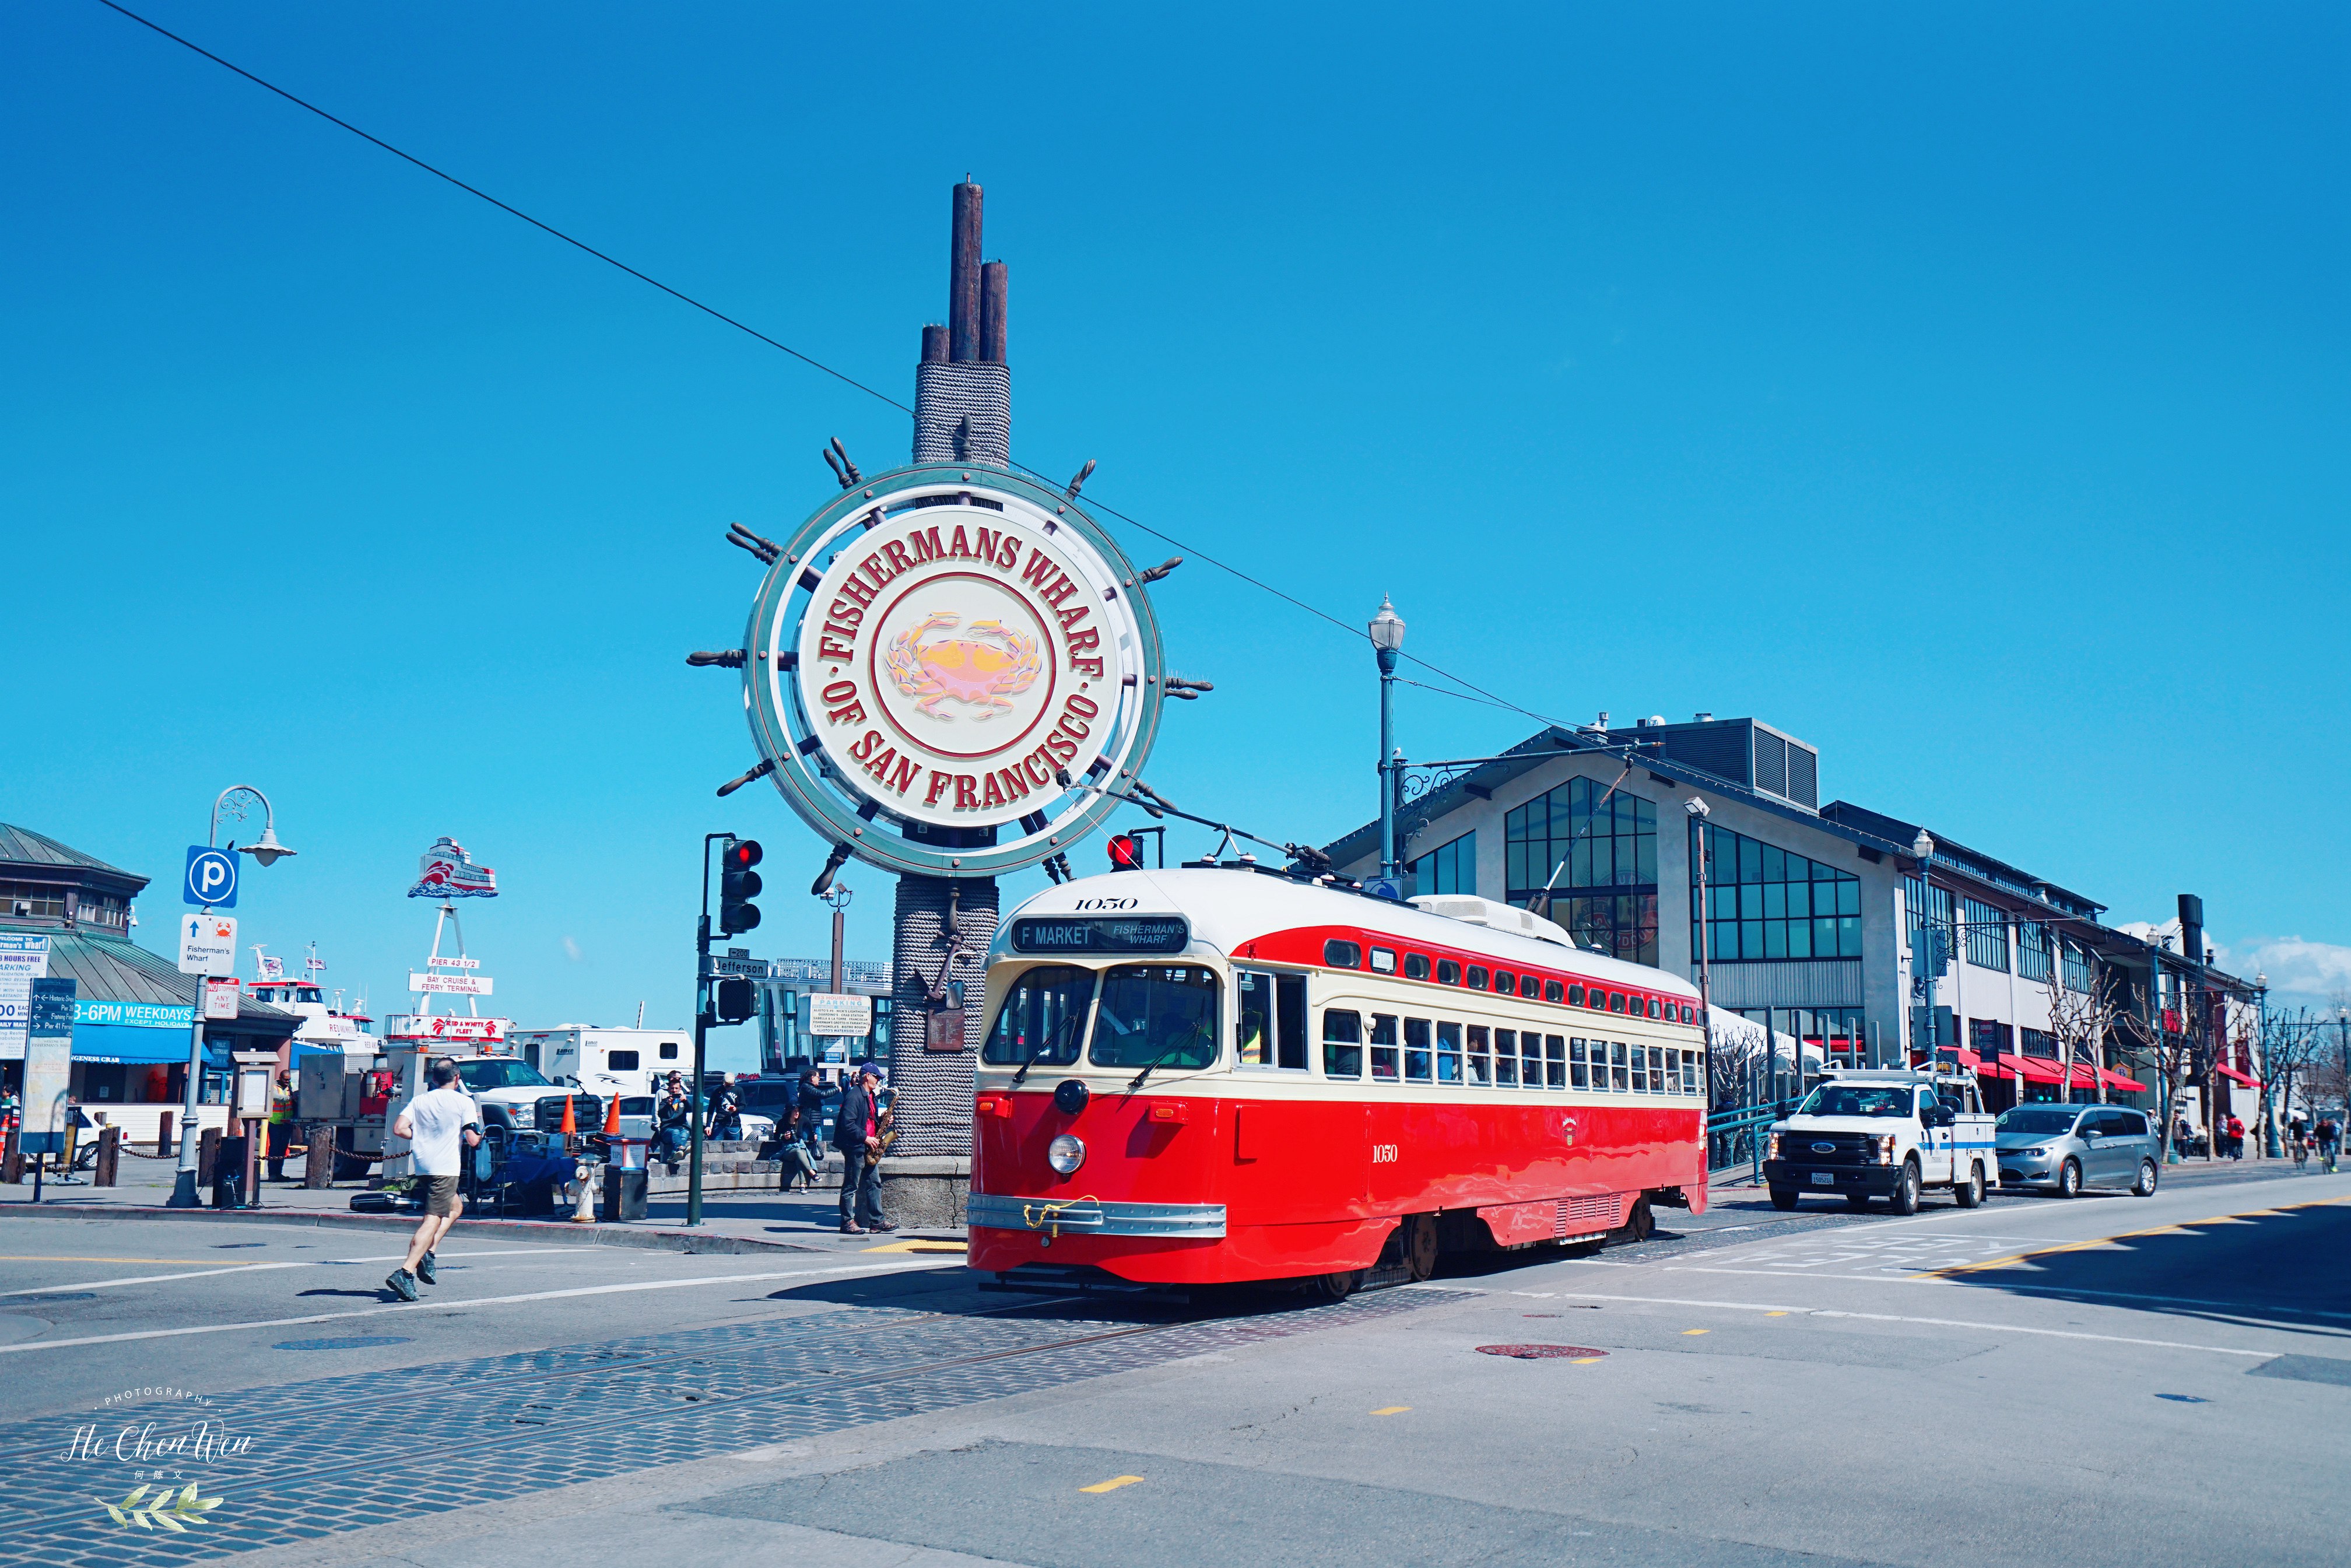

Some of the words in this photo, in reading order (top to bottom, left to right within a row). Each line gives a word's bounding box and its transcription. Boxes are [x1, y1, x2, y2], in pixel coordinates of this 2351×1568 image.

[819, 524, 1022, 662] FISHERMANS
[1023, 547, 1104, 679] WHARF
[822, 680, 868, 725] OF
[850, 729, 922, 797] SAN
[925, 694, 1099, 810] FRANCISCO
[1071, 898, 1138, 911] 1050
[1582, 904, 1606, 914] SINCE
[1022, 927, 1030, 944] F
[1036, 927, 1091, 944] MARKET
[1113, 925, 1185, 934] FISHERMAN'S
[25, 938, 45, 949] Wharf
[1129, 935, 1167, 944] WHARF
[187, 945, 230, 955] Fisherman's
[714, 960, 763, 974] Jefferson
[74, 1004, 121, 1021] 3-6PM
[125, 1006, 191, 1020] WEEKDAYS
[1372, 1144, 1398, 1163] 1050
